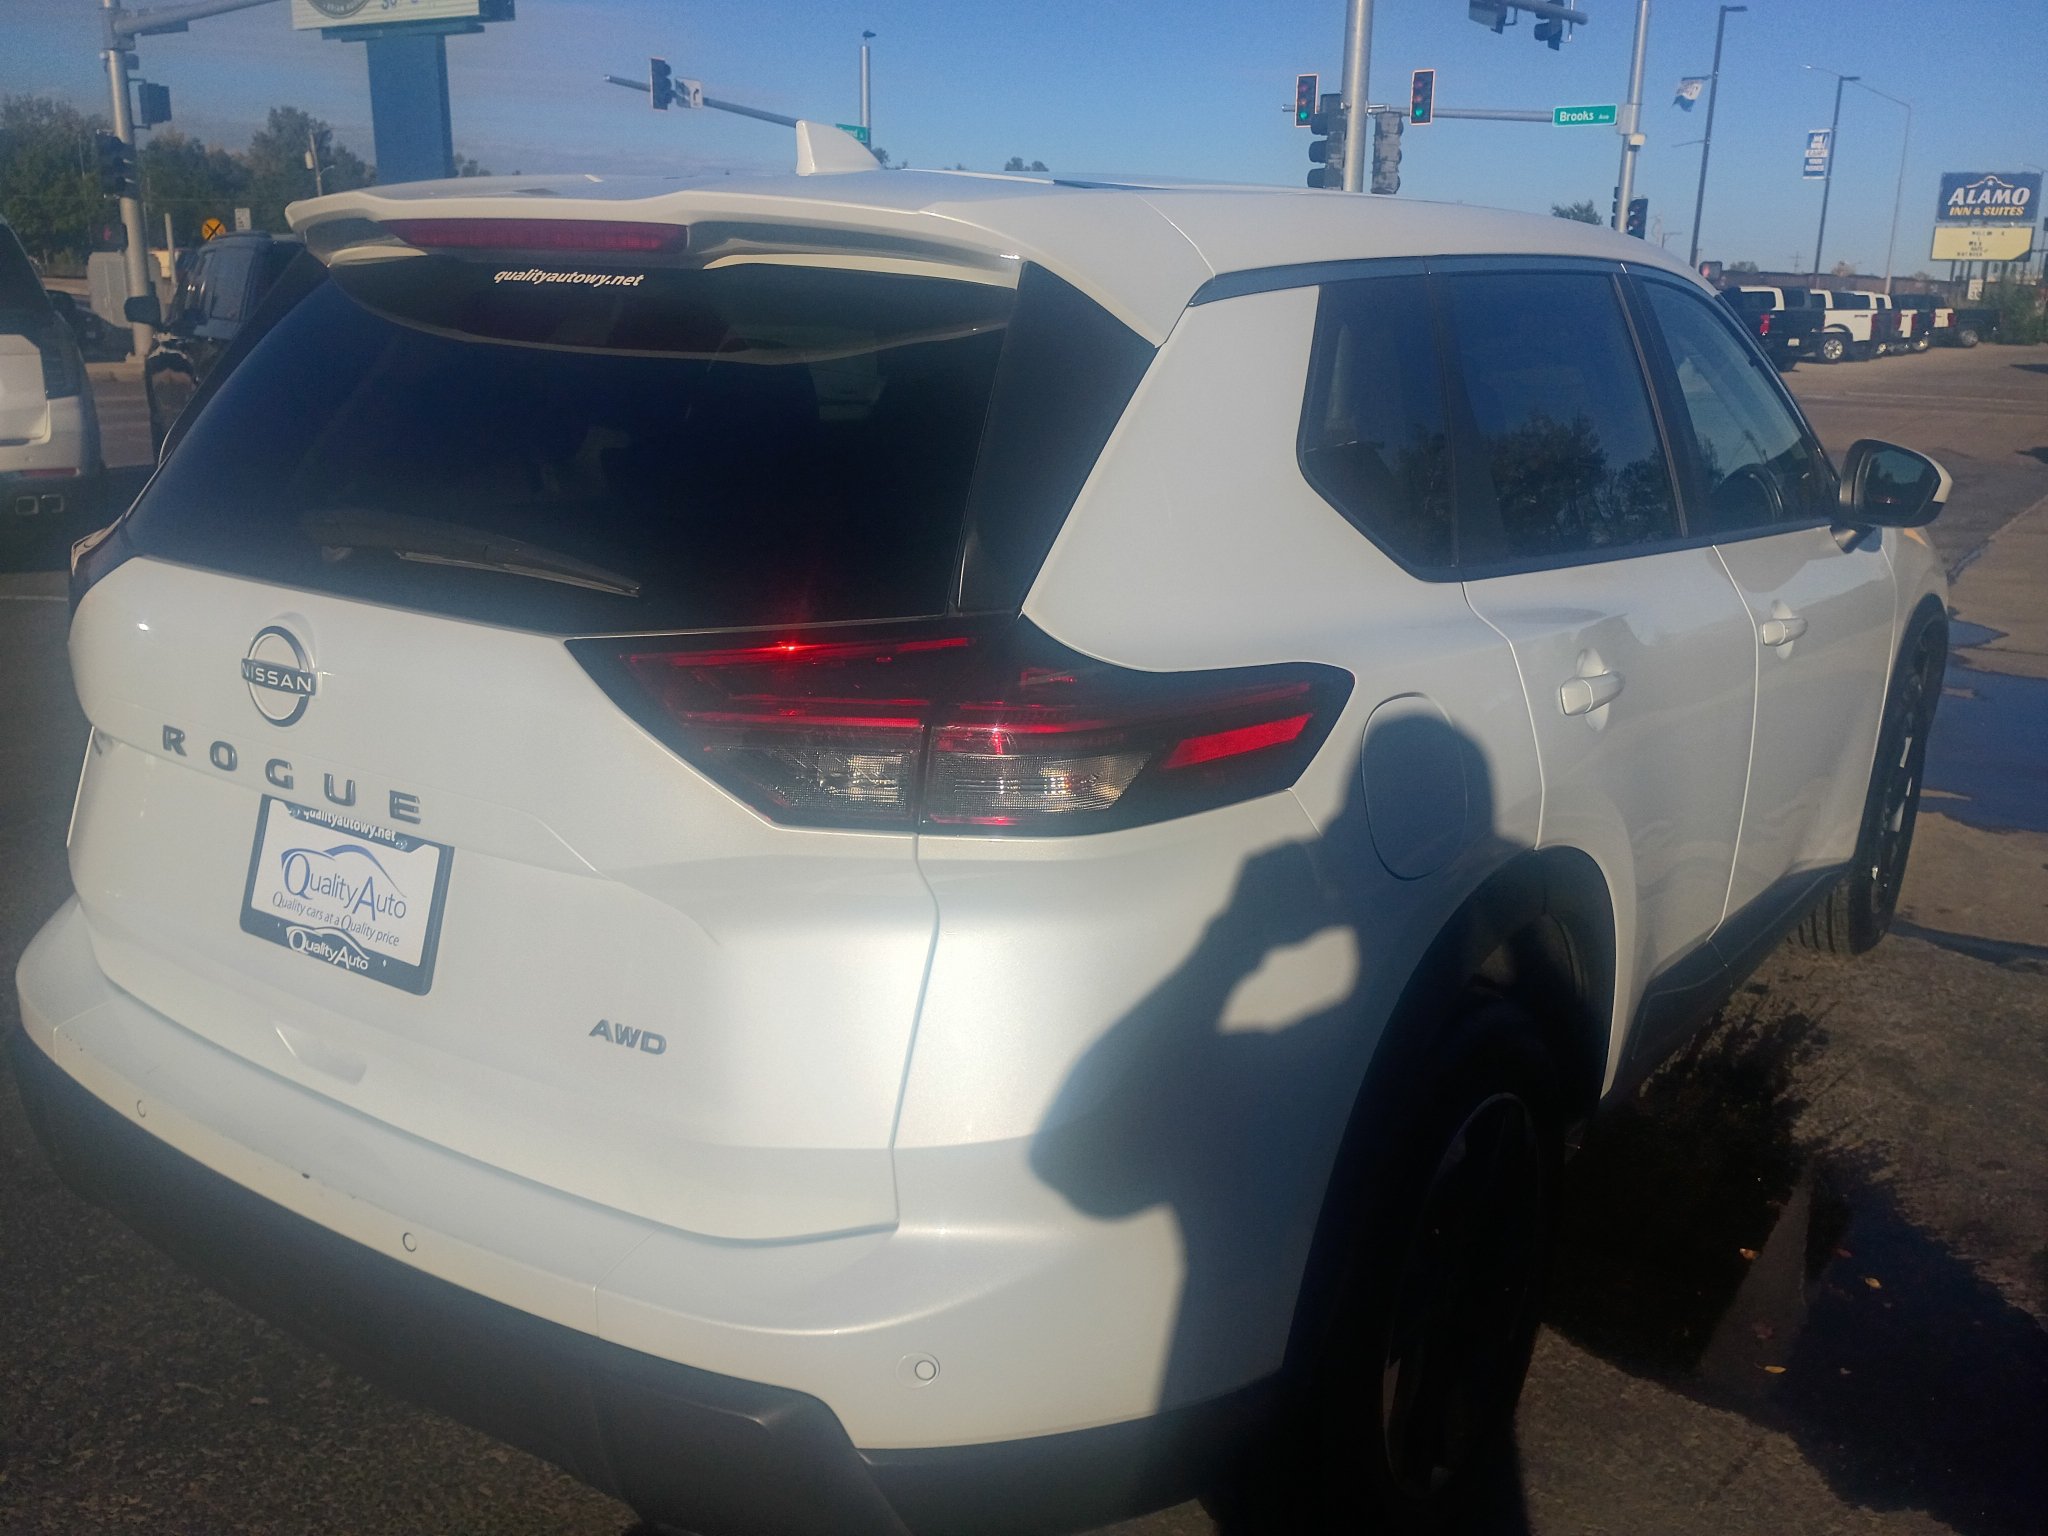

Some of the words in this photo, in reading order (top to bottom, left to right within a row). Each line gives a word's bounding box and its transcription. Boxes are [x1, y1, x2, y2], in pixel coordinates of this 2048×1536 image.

[1560, 111, 1594, 121] Brooks
[1947, 187, 2031, 206] ALAMO
[1949, 206, 1972, 216] INN
[1973, 207, 1981, 216] &
[1982, 206, 2025, 216] SUITES
[493, 268, 645, 288] qualityautowy.net
[242, 662, 312, 692] NISSAN
[162, 724, 422, 825] ROGUE
[284, 853, 407, 922] QualityAuto
[272, 891, 306, 917] Quality
[306, 906, 323, 922] cars
[324, 912, 334, 925] at
[333, 917, 341, 926] a
[341, 914, 376, 941] Quality
[375, 930, 400, 947] price
[288, 929, 369, 970] QualityAuto
[589, 1019, 667, 1055] AWD
